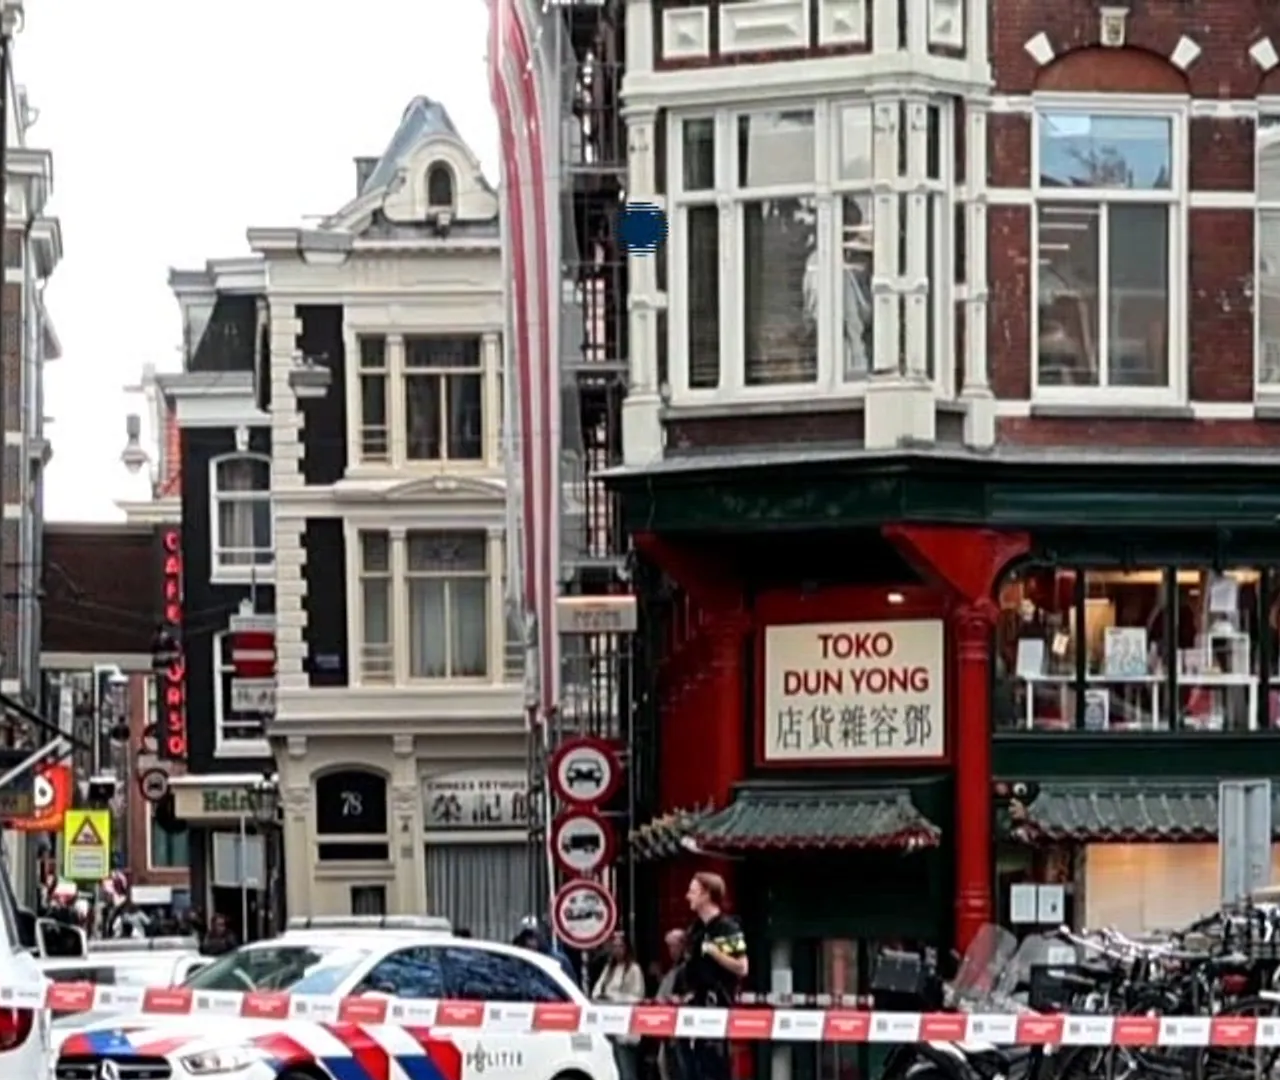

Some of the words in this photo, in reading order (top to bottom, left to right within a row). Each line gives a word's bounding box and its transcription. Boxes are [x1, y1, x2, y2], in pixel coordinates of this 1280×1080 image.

[817, 631, 894, 660] TOKO
[783, 669, 844, 696] DUN
[849, 667, 930, 694] YONG
[341, 790, 363, 816] 78
